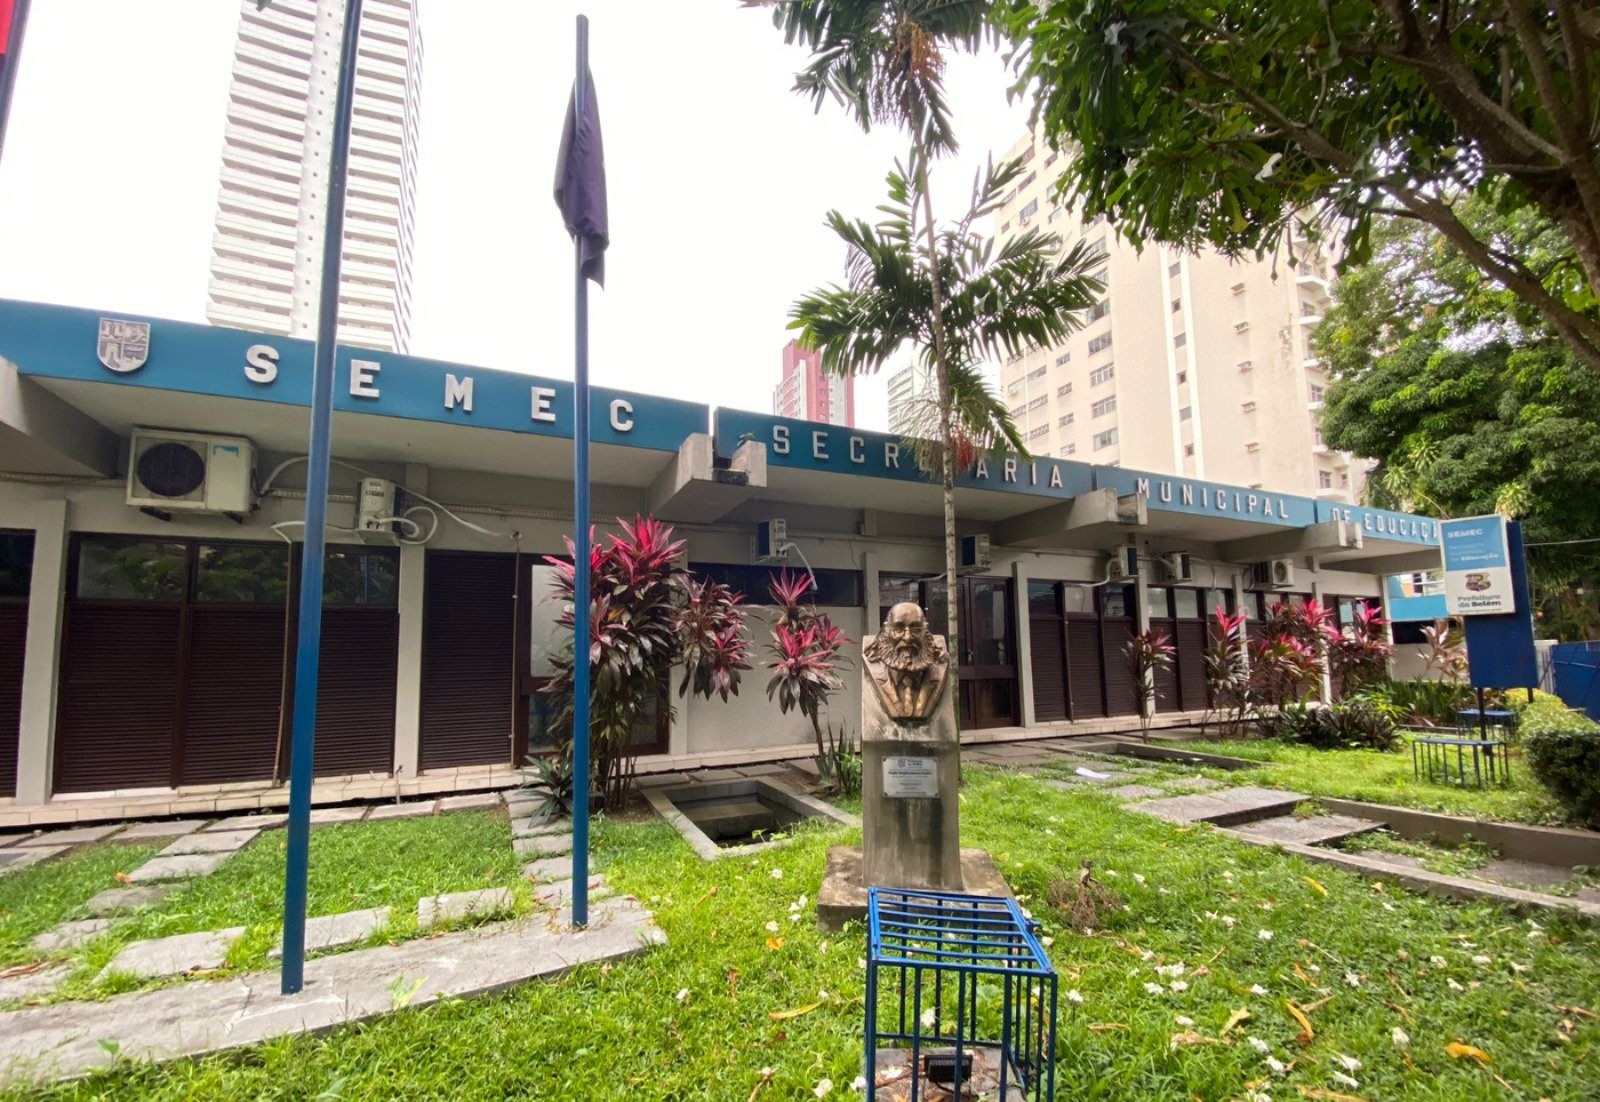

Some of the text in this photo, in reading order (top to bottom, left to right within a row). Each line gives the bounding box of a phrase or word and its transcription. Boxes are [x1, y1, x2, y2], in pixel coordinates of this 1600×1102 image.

[243, 343, 634, 432] SEMEC
[772, 424, 1064, 490] SECRARIA
[1136, 477, 1289, 519] MUNICIPAL
[1447, 528, 1484, 538] SEMEC
